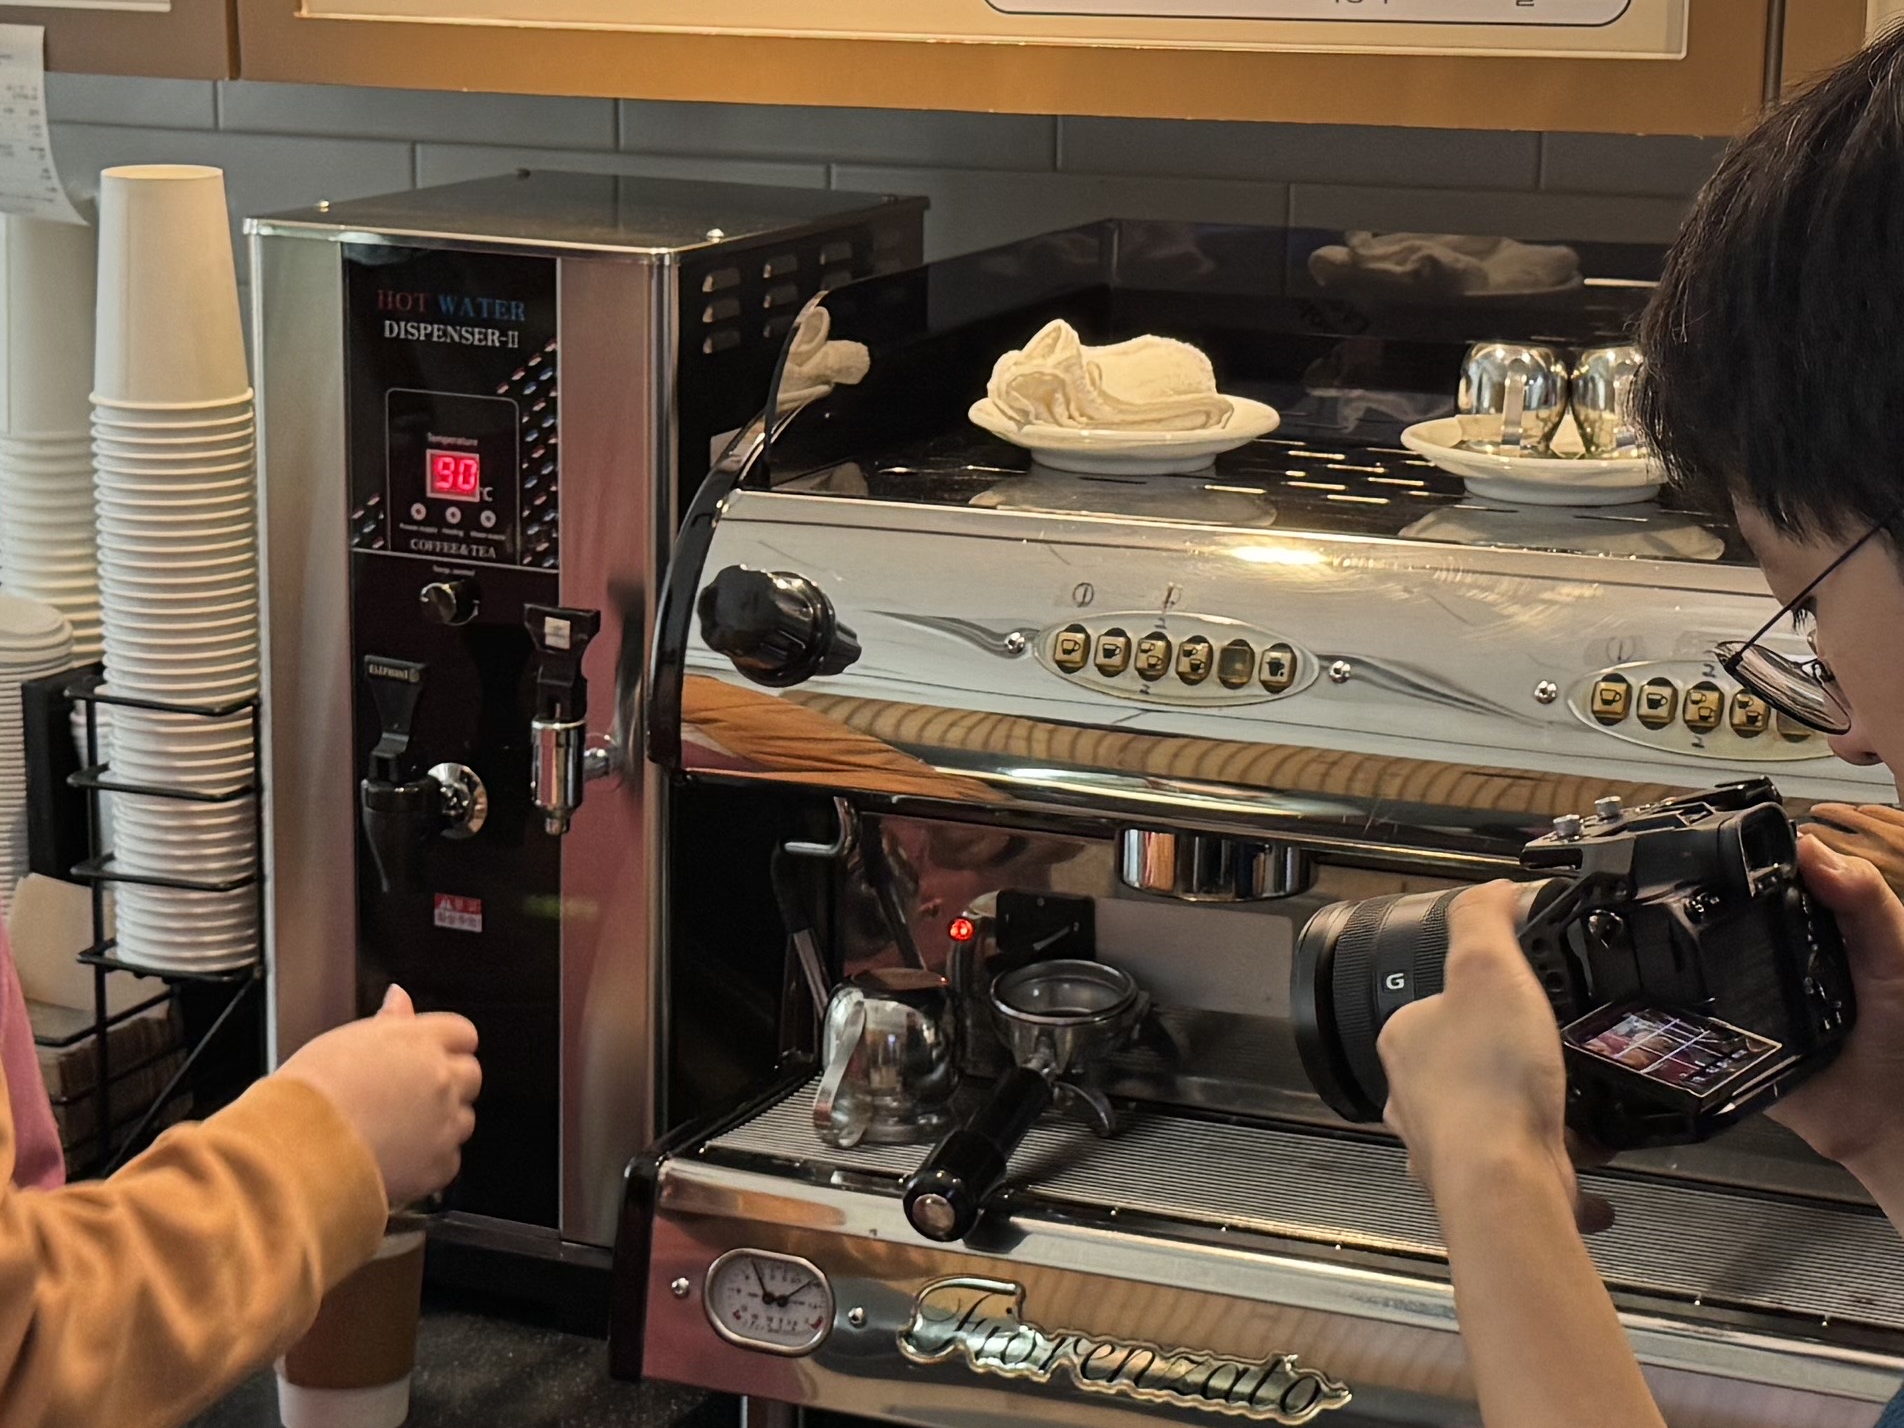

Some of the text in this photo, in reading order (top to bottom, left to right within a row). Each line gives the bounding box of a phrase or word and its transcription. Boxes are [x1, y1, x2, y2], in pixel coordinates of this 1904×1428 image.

[377, 290, 526, 321] HOT WATER
[435, 456, 479, 491] 90
[1384, 972, 1406, 991] G
